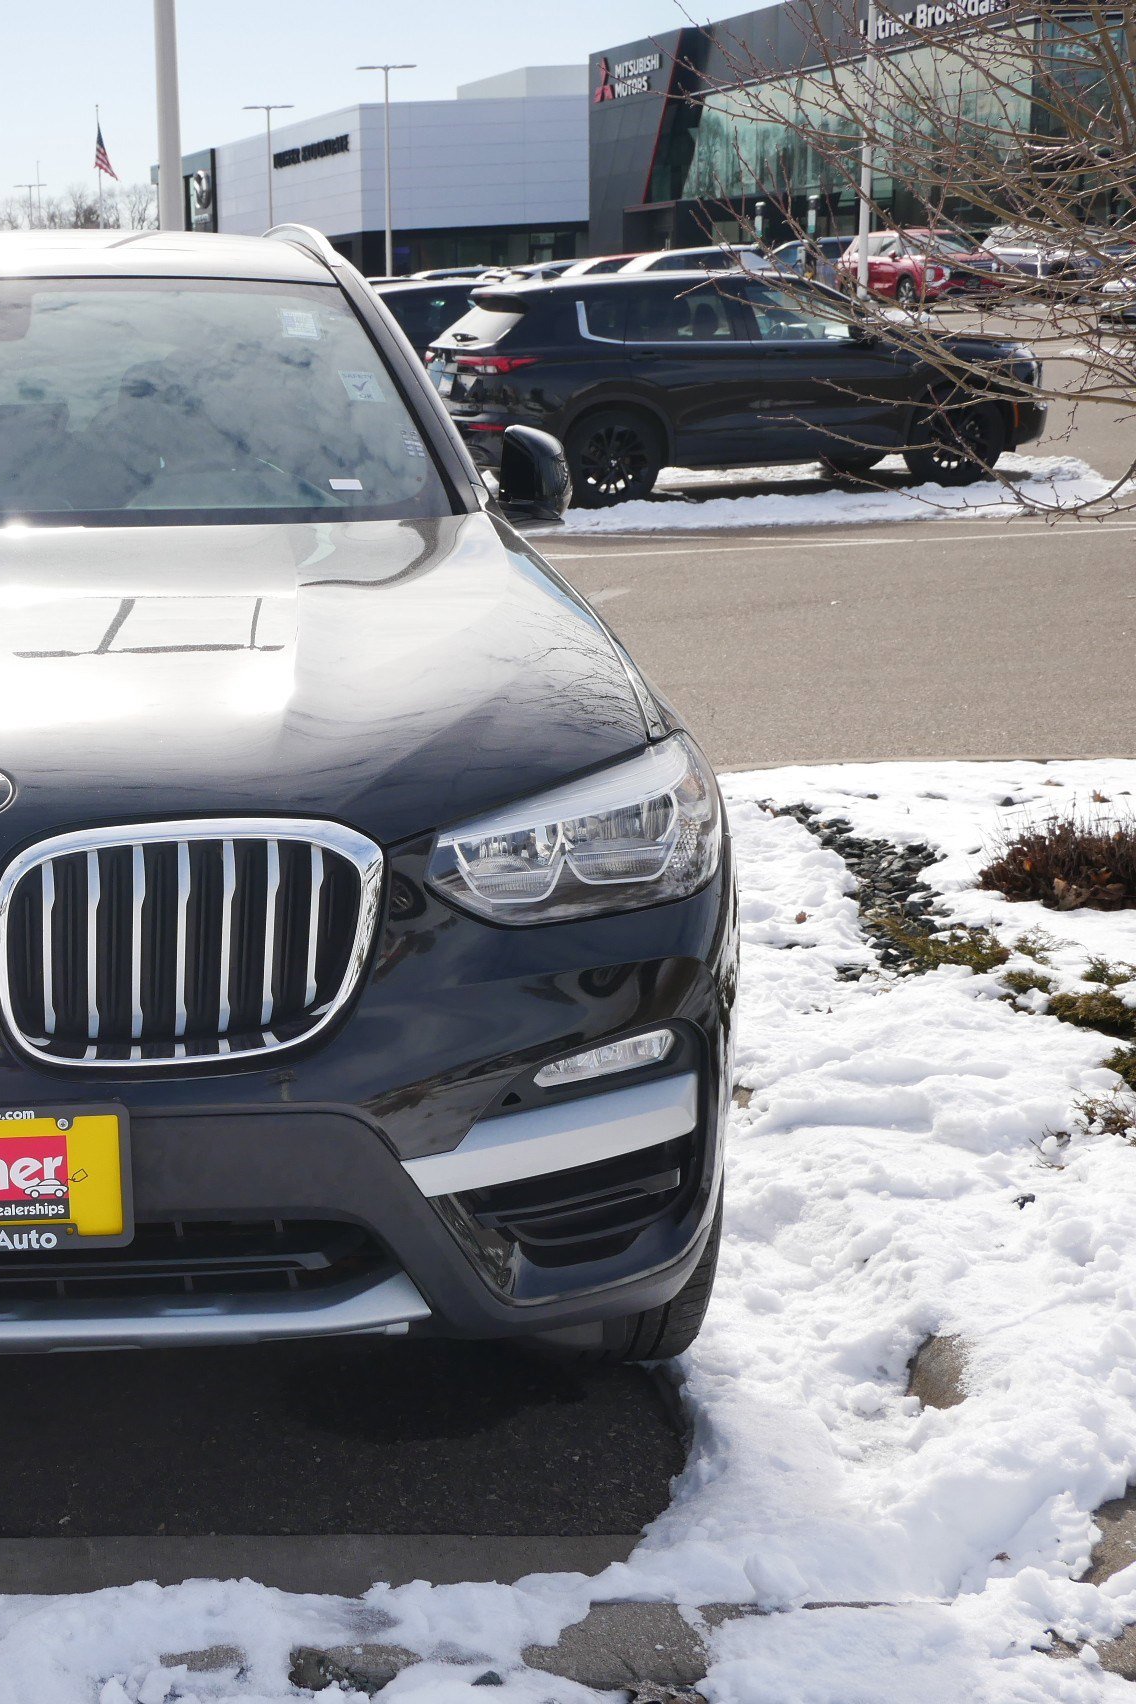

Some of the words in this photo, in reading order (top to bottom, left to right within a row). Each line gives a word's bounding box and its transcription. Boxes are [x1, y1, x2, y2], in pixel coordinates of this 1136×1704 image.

[859, 12, 913, 39] Lther
[615, 53, 660, 79] MITSUBISHI
[615, 76, 648, 98] MOTORS
